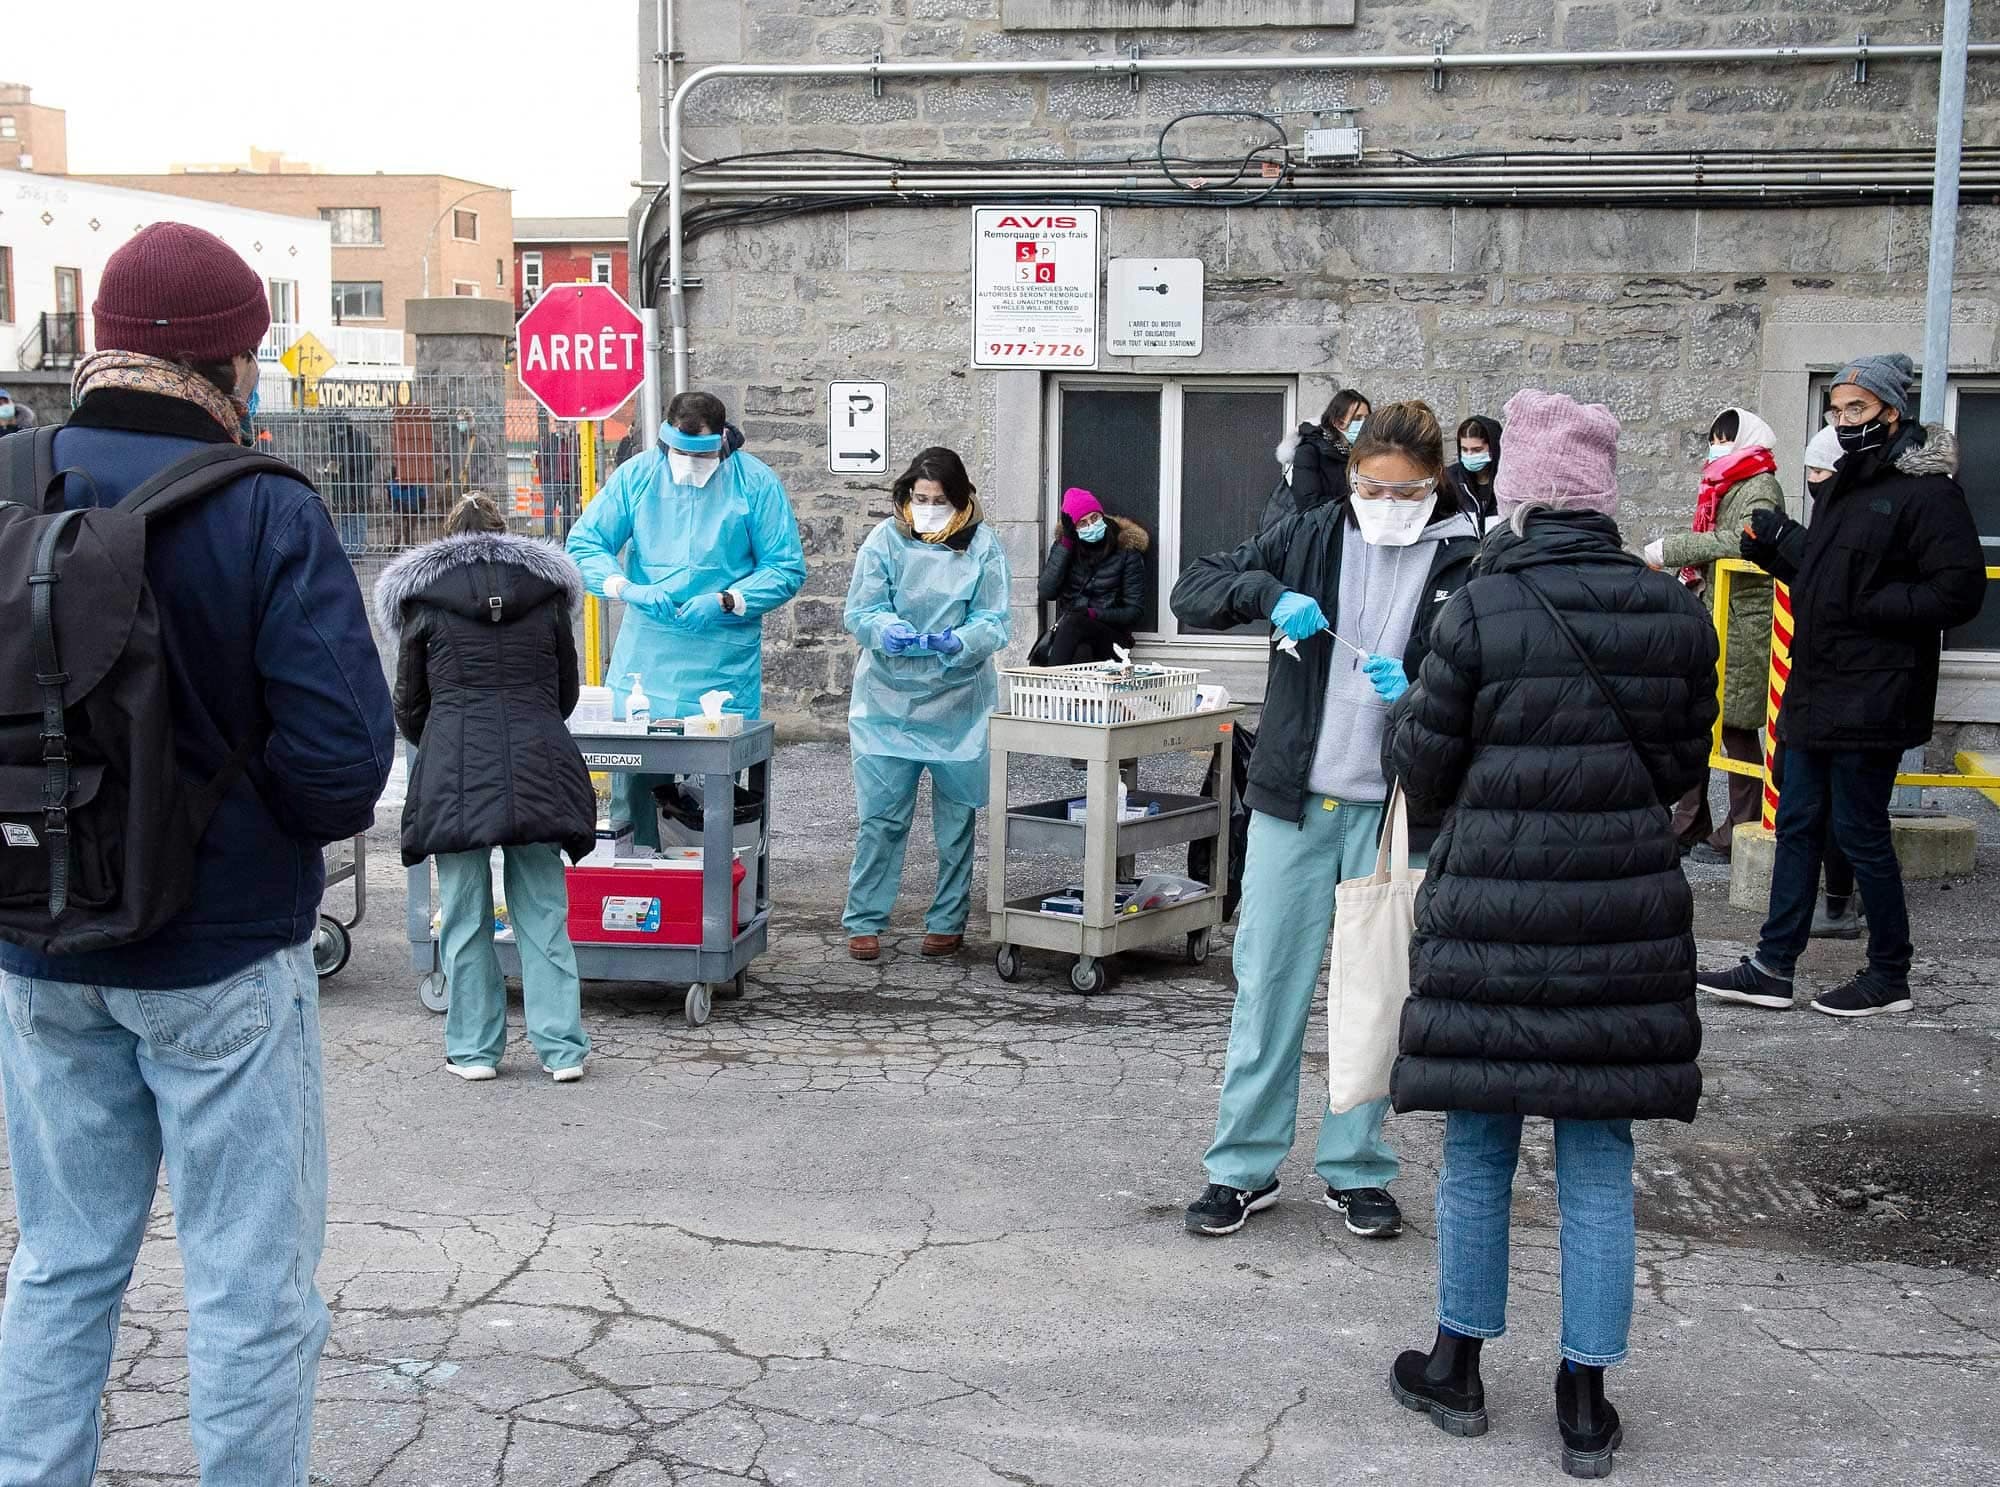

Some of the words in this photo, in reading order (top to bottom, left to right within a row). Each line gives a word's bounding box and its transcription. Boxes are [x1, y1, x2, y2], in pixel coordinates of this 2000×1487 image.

[997, 216, 1077, 228] AVIS
[984, 231, 1040, 240] Remorquage
[1069, 231, 1088, 239] frais
[526, 326, 638, 371] ARRÊT
[990, 344, 1085, 356] 977-7726
[849, 395, 874, 428] P
[584, 754, 641, 765] MEDICAUX
